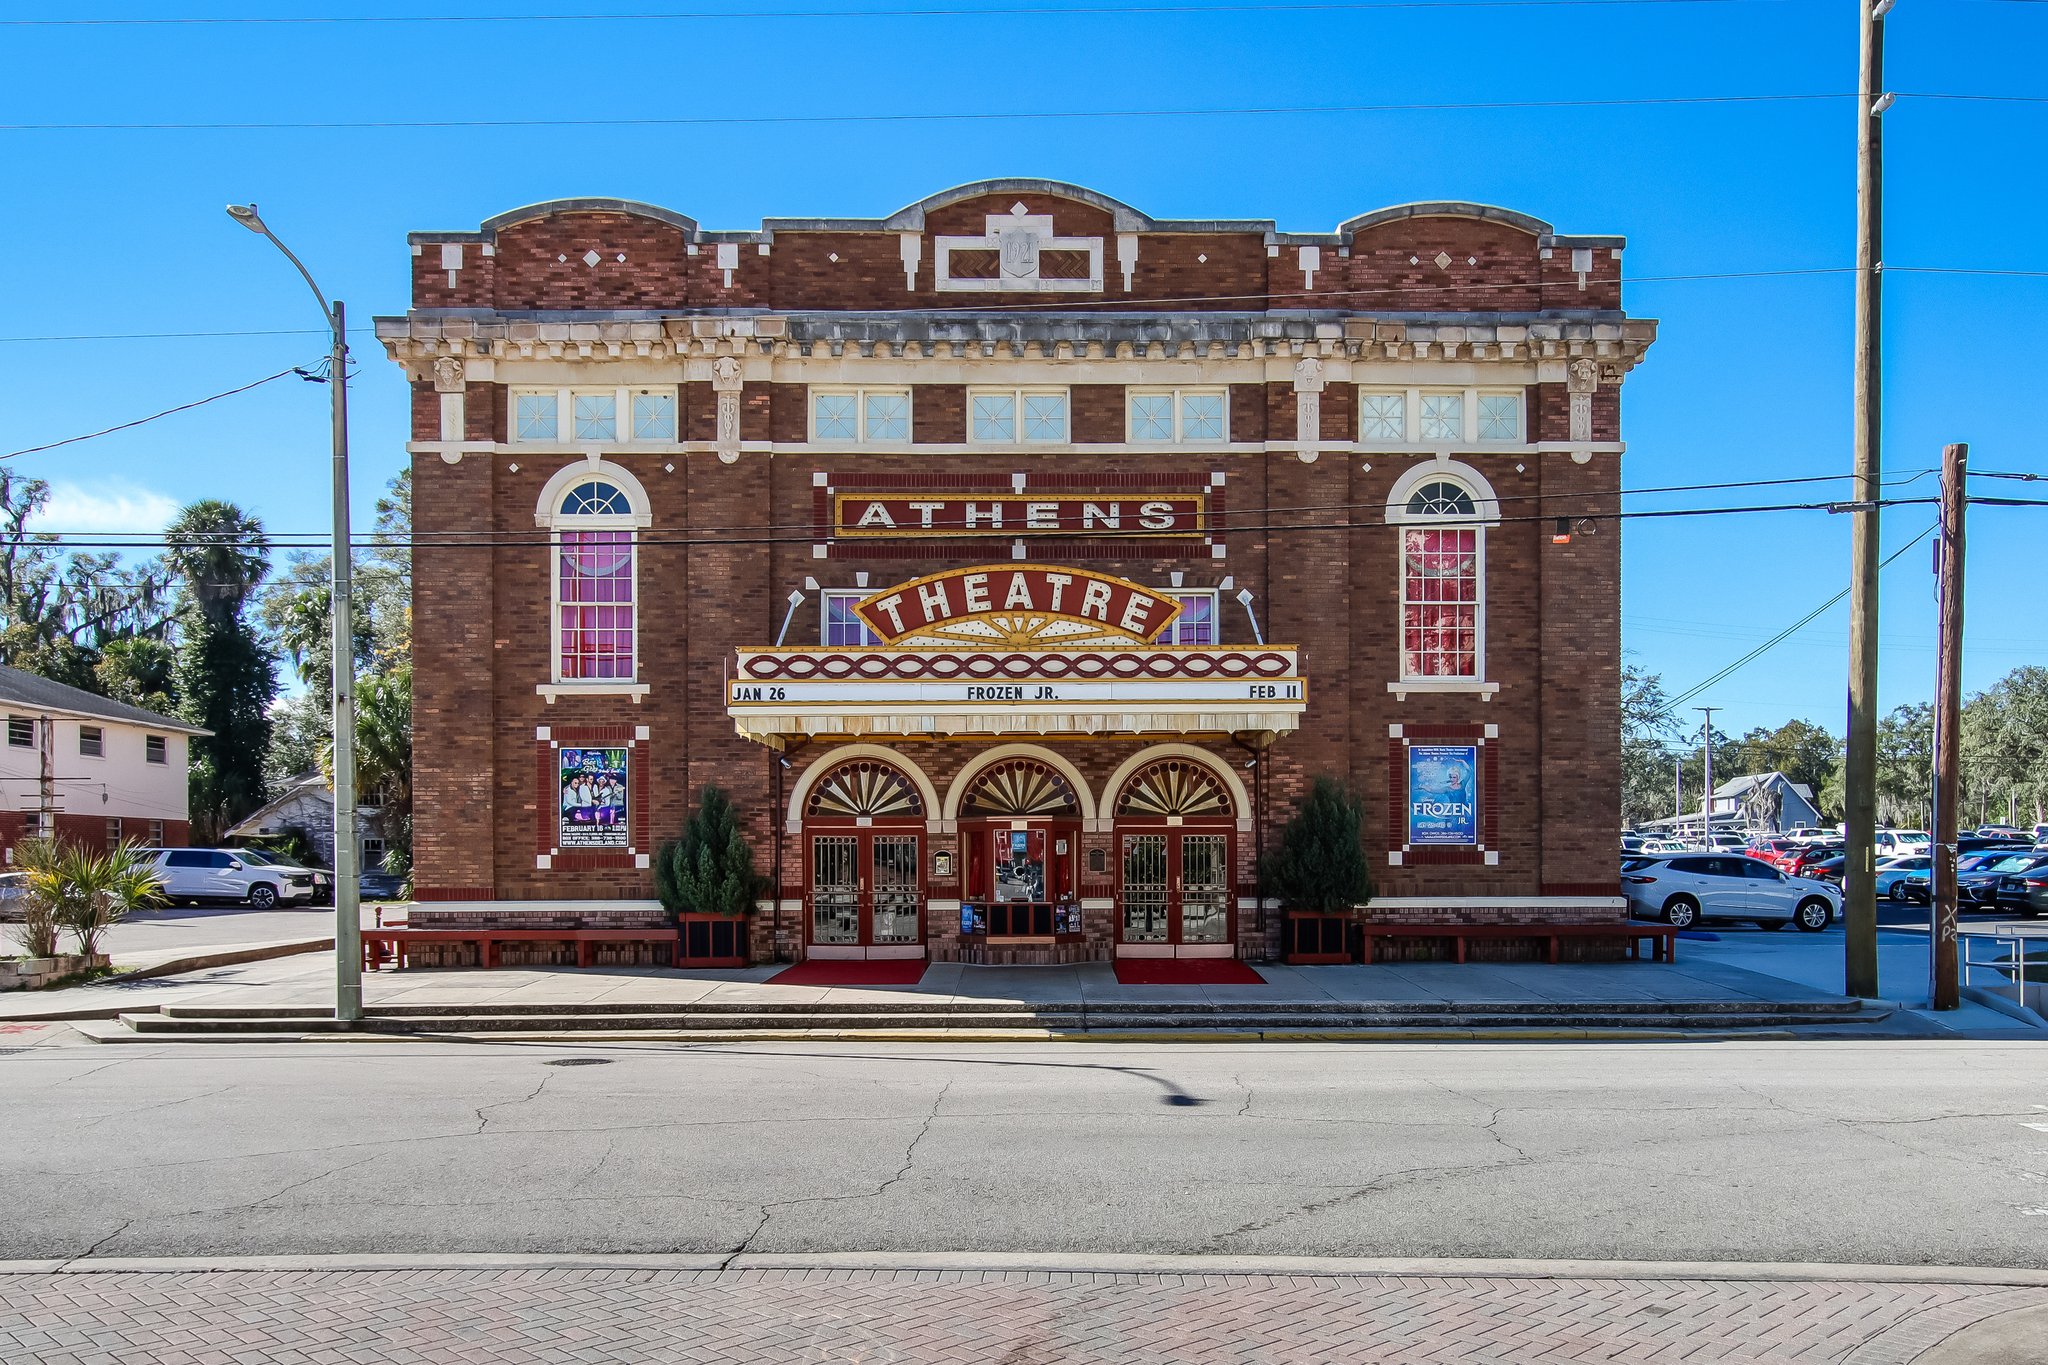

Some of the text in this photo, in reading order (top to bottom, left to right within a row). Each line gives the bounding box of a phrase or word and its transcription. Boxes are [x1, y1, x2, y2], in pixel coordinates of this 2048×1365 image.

[1006, 241, 1034, 264] 1921
[857, 501, 1176, 529] ATHENS
[876, 571, 1155, 635] THEATRE
[733, 687, 786, 700] JAN 26
[967, 686, 1059, 700] FROZEN JR.
[1249, 685, 1276, 698] FEB
[1413, 802, 1472, 818] FROZEN
